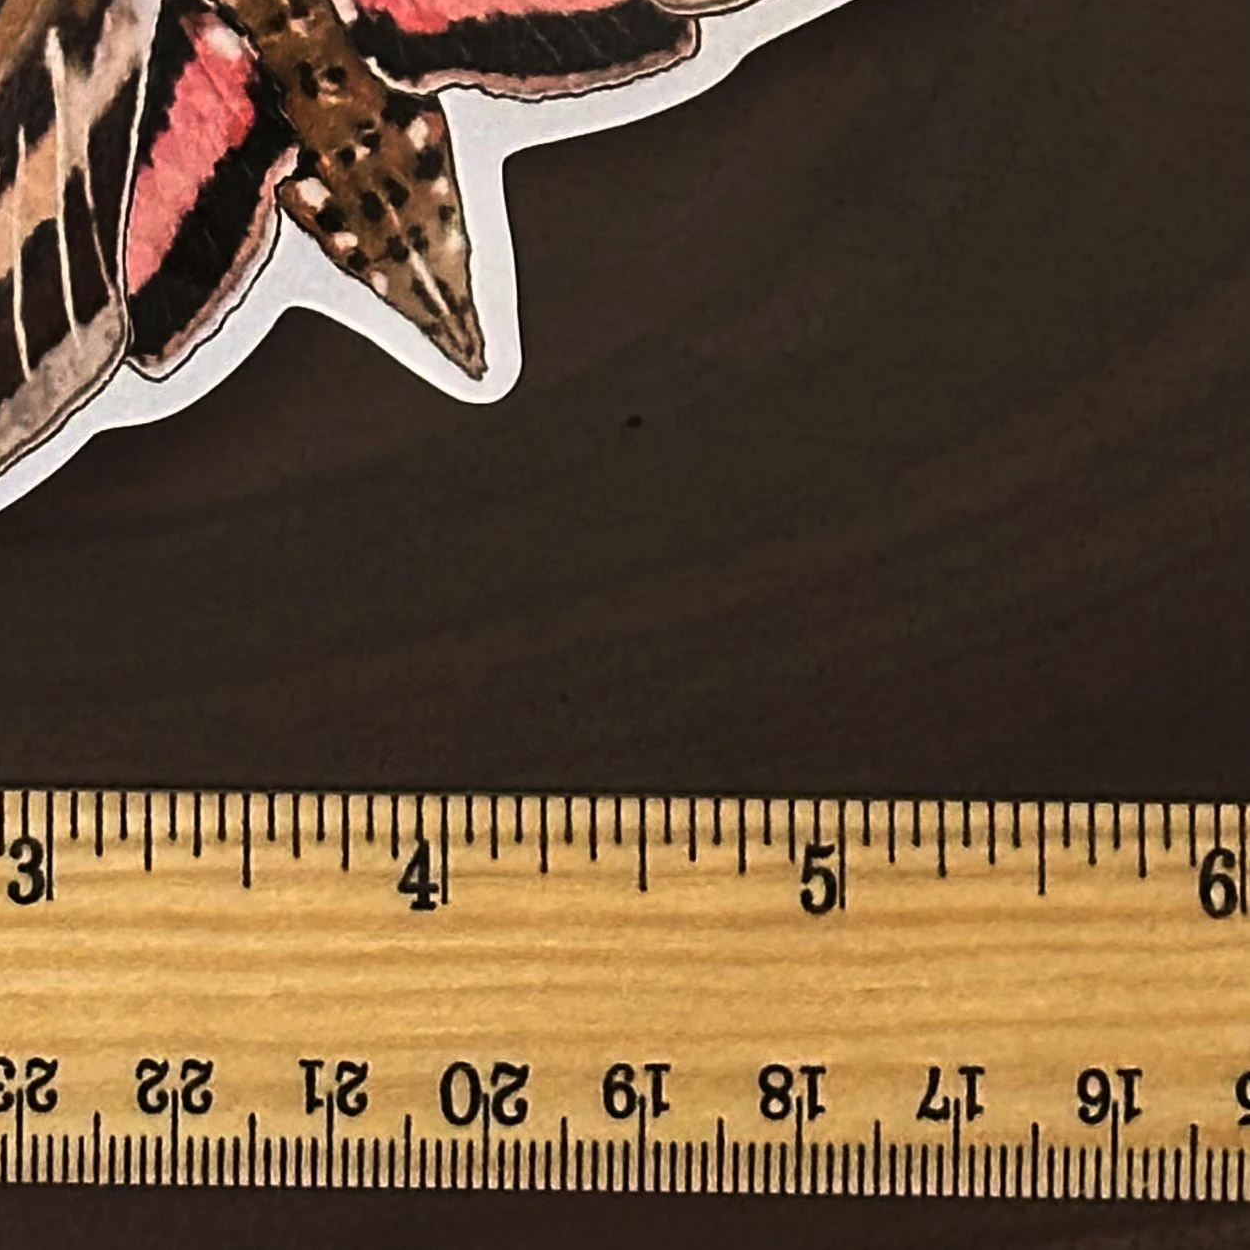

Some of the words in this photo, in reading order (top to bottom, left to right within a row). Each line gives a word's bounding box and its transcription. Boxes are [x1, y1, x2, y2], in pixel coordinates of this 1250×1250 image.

[6, 834, 46, 906] 3
[398, 839, 439, 911] 4
[799, 843, 839, 916] 5
[1199, 847, 1238, 919] 6
[135, 1057, 214, 1116] 22
[298, 1058, 369, 1118] 21
[438, 1060, 530, 1127] 20
[601, 1062, 671, 1120] 19
[757, 1063, 827, 1122] 18
[916, 1065, 985, 1123] 17
[1076, 1067, 1143, 1124] 16
